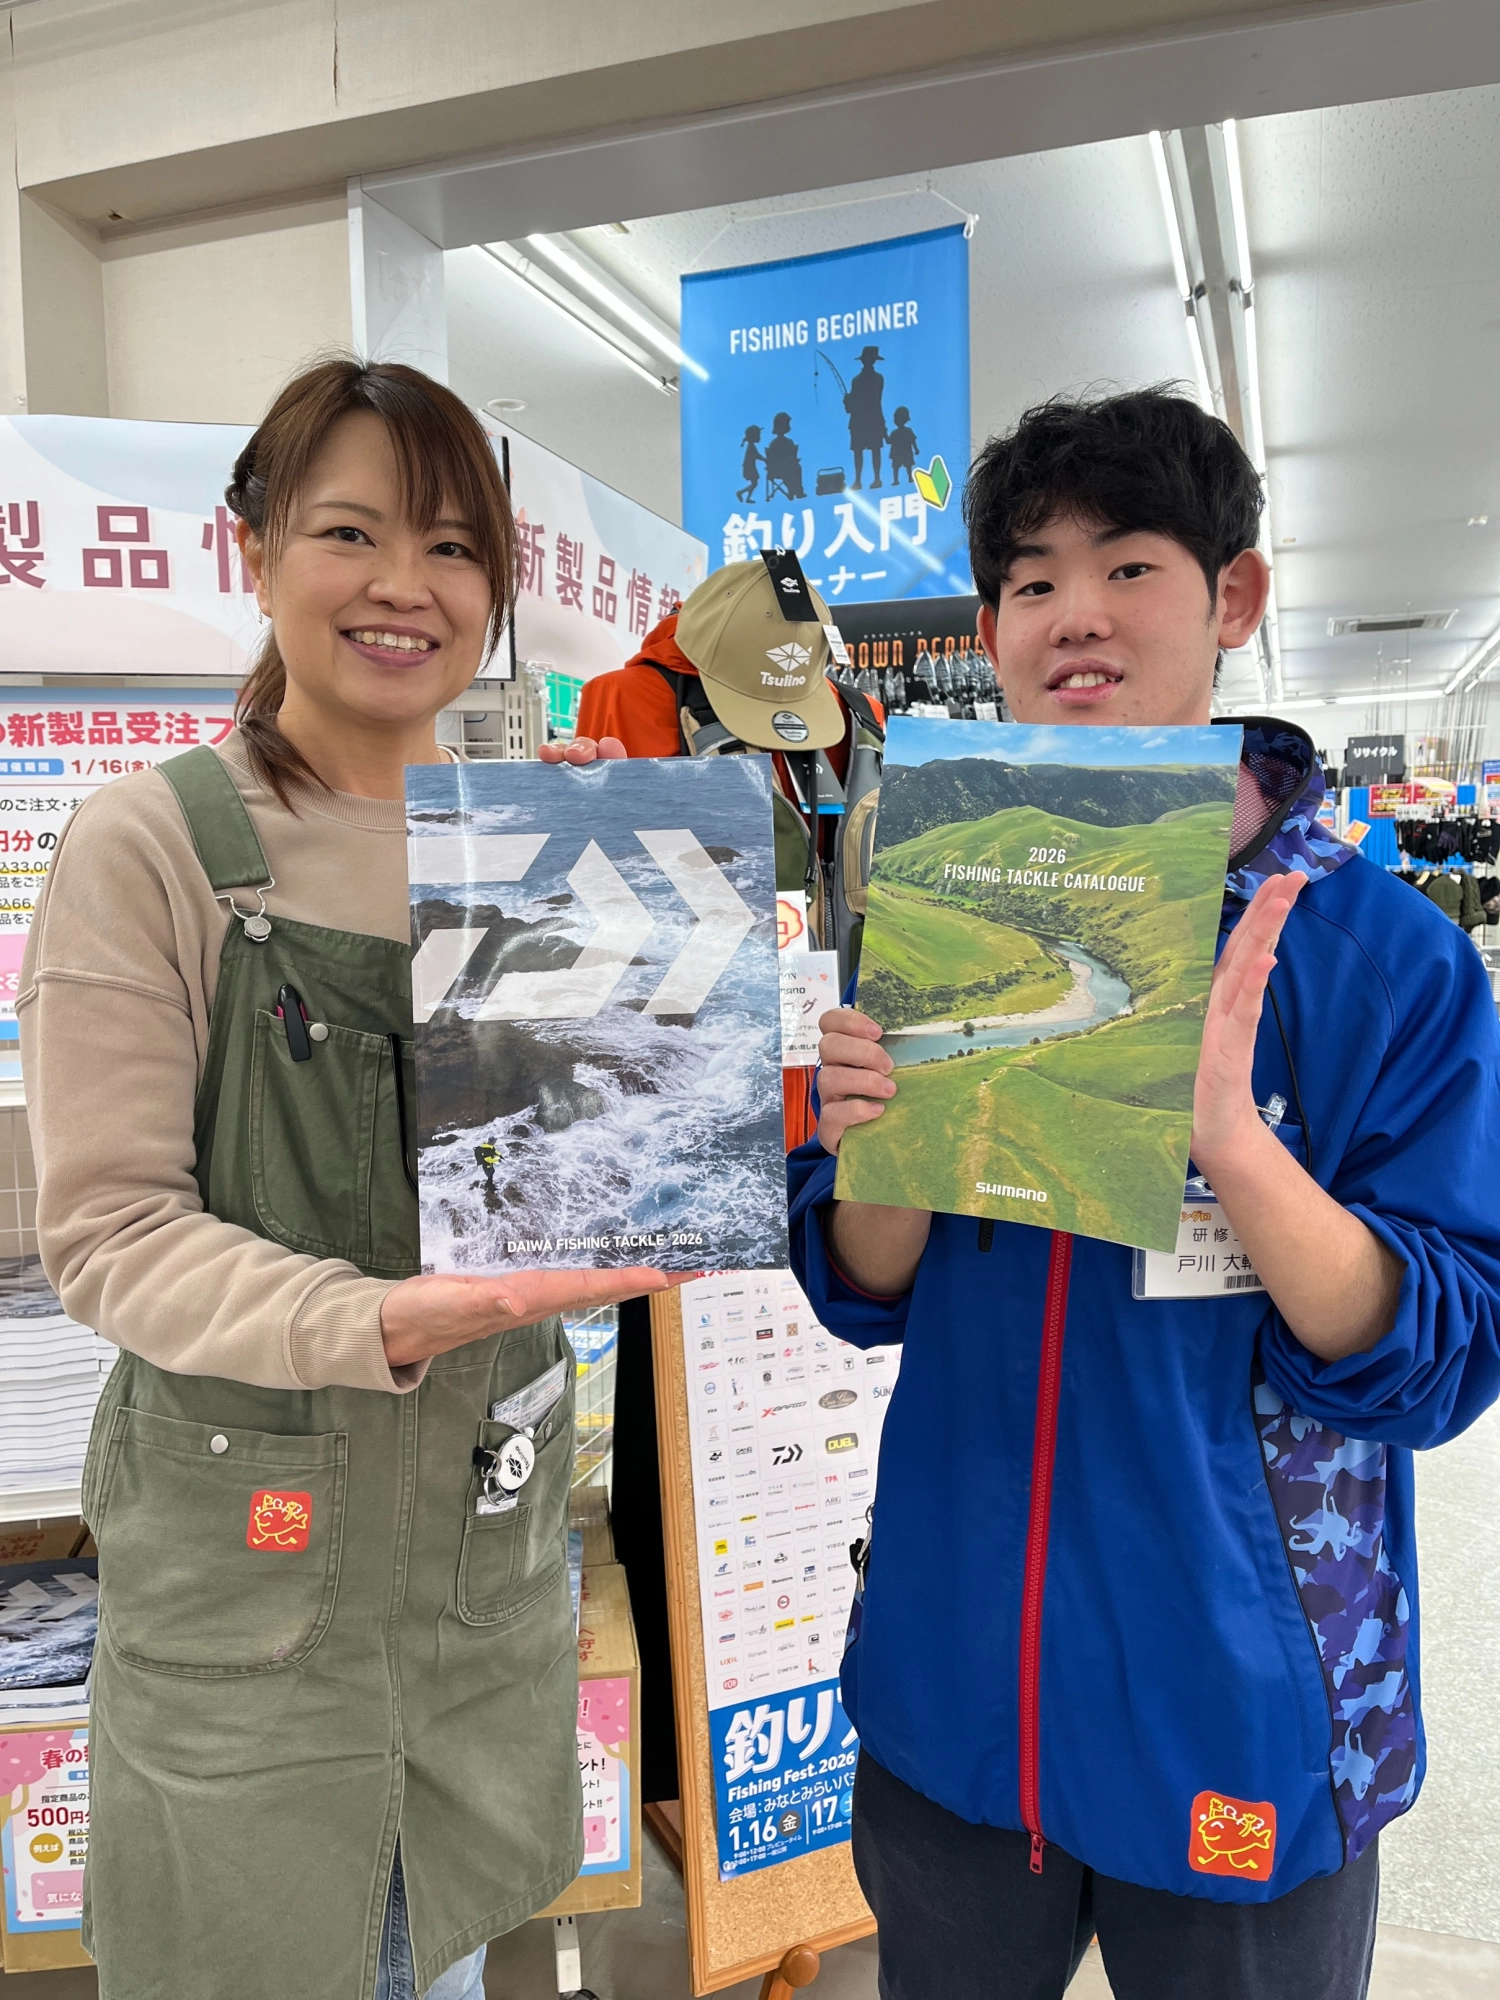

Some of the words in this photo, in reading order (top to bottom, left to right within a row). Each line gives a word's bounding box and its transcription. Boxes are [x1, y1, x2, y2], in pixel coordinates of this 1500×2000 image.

[730, 320, 808, 354] FISHING
[816, 300, 919, 343] BEGINNER
[722, 493, 929, 566] 釣り入門
[760, 671, 806, 688] Tsulino
[0, 711, 235, 748] 新製品受注フ
[1353, 745, 1398, 759] リサイクル
[1029, 847, 1066, 864] 2026
[944, 864, 1001, 883] FISHING
[1007, 868, 1059, 888] TACKLE
[1064, 873, 1146, 893] CATALOGUE
[976, 1182, 1047, 1203] SHIMANO
[507, 1239, 553, 1253] DAIWA
[556, 1236, 610, 1251] FISHING
[612, 1233, 665, 1249] TACKLE
[672, 1232, 703, 1246] 2026
[1193, 1228, 1239, 1242] 研修
[828, 1437, 855, 1450] DUEL
[514, 1445, 531, 1471] Tsulino
[728, 1777, 782, 1803] Fishing
[729, 1815, 777, 1851] 1.16
[782, 1814, 798, 1833] 金
[811, 1796, 838, 1826] 17
[47, 1891, 83, 1904] 気にな
